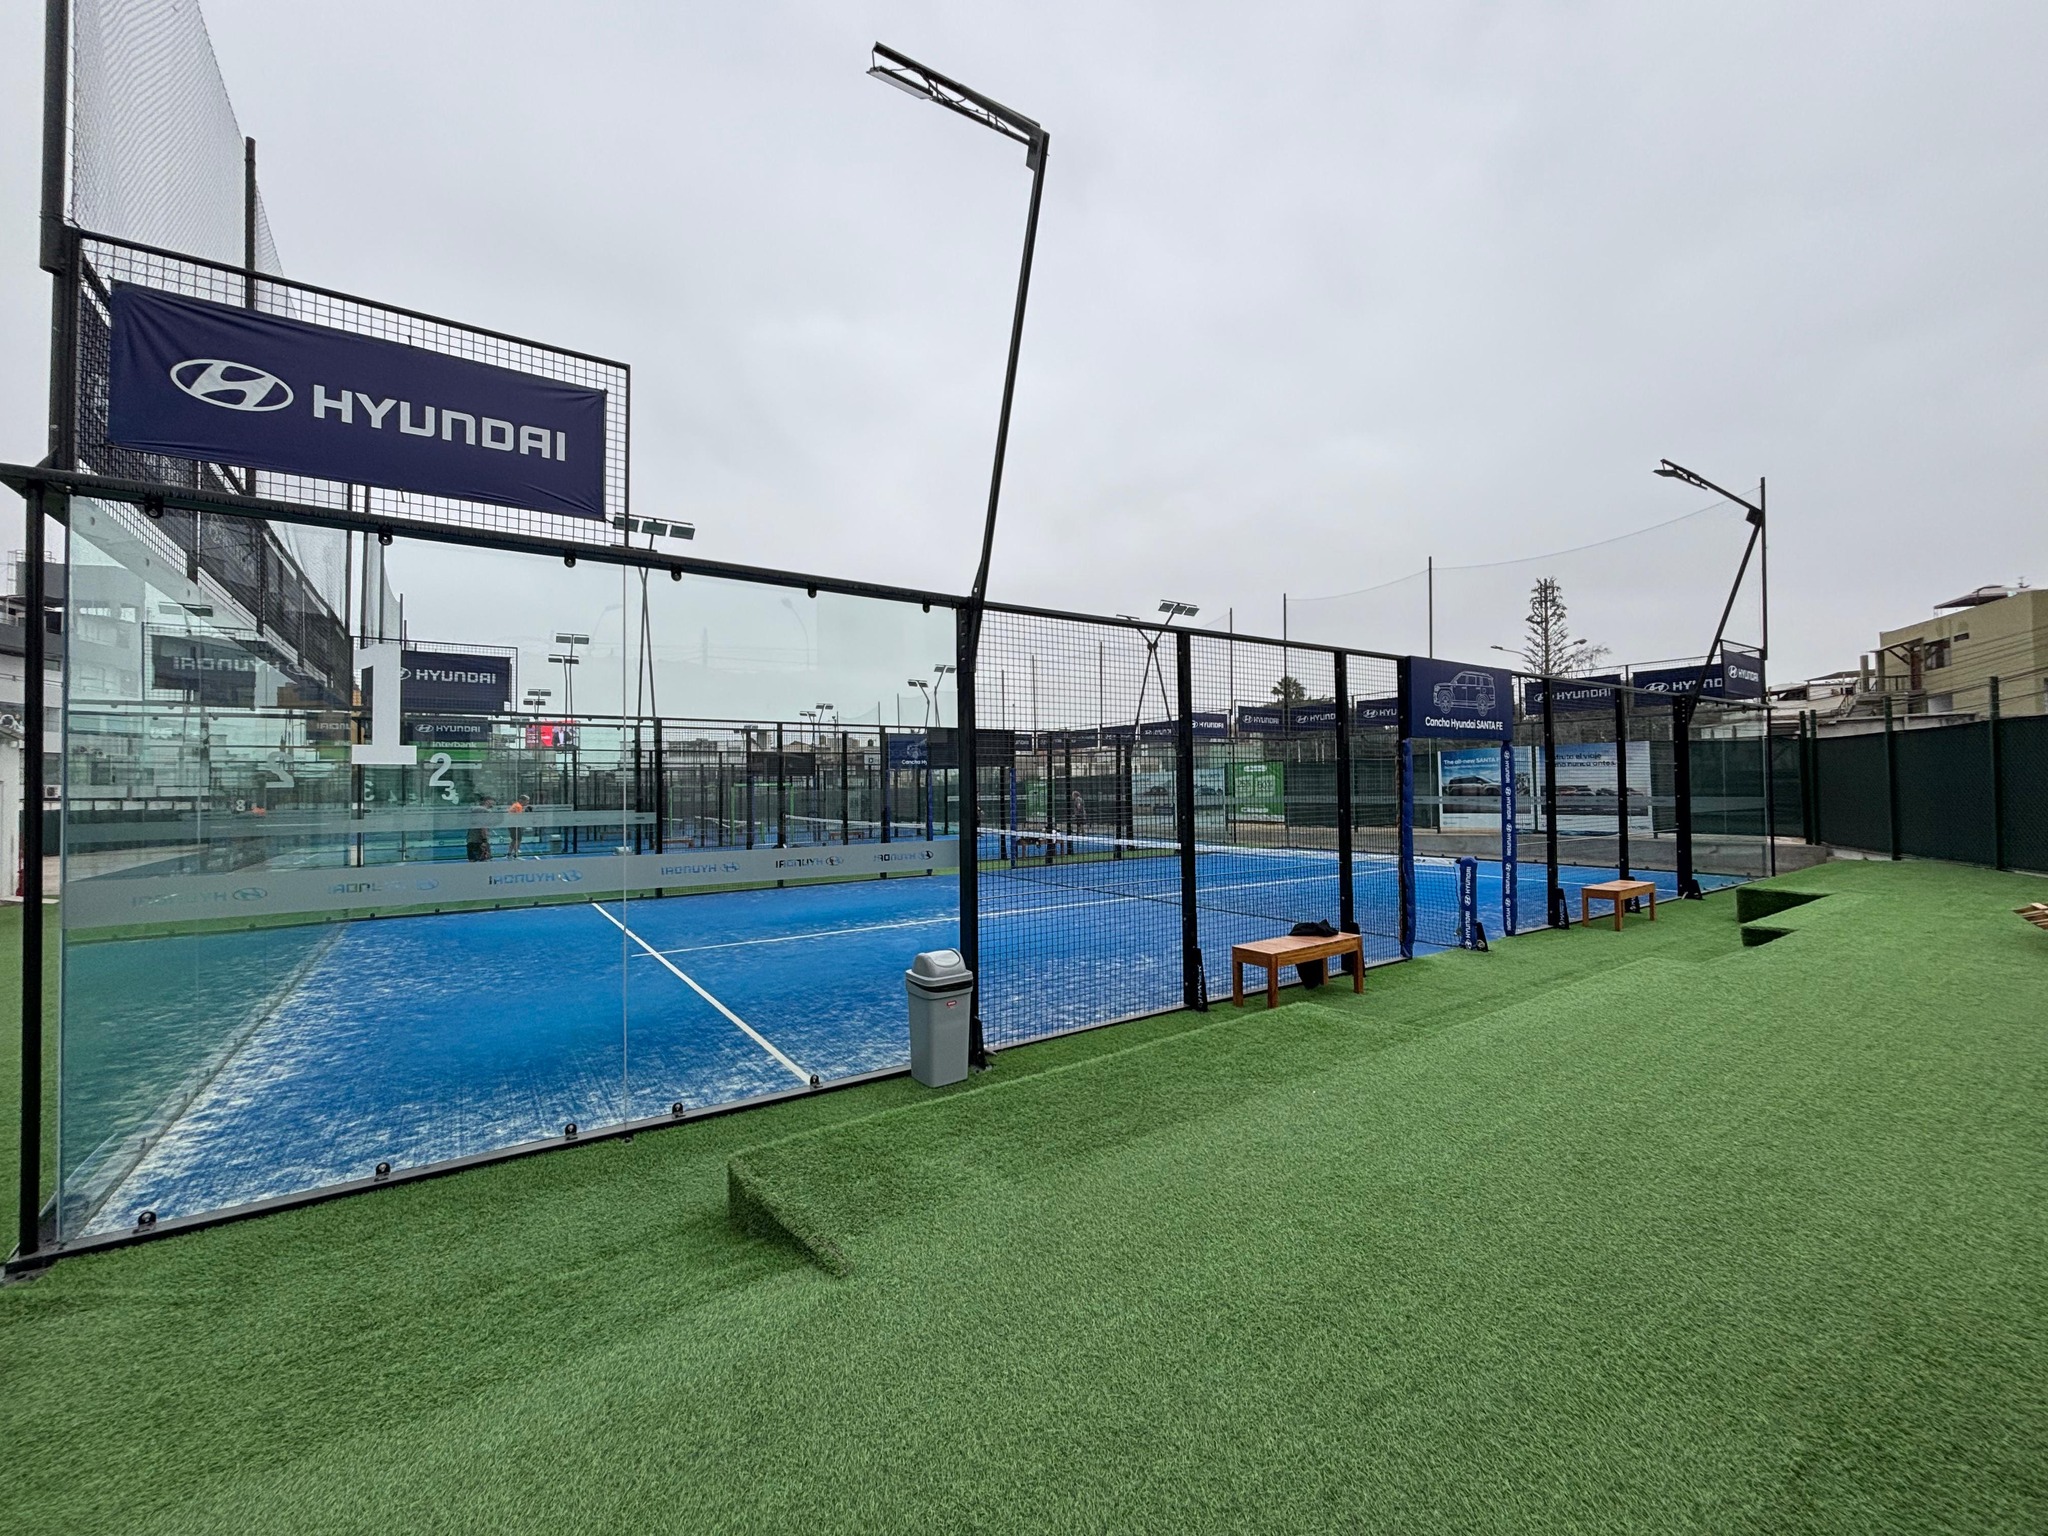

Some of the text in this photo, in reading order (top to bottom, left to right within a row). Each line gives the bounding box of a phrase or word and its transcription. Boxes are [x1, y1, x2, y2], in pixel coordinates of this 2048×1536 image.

[313, 384, 566, 462] HYUNDAI
[415, 667, 497, 686] HYUNDAI
[1738, 668, 1759, 683] HYUNDAI
[1556, 687, 1612, 701] HYUNDAI
[352, 642, 418, 765] 1
[1253, 715, 1280, 725] HYUNDAI
[1309, 712, 1336, 723] HYUND
[1425, 716, 1504, 731] Cancha Hyundai SANTA FE
[435, 724, 481, 733] HYUNDAI
[432, 740, 477, 748] interbank
